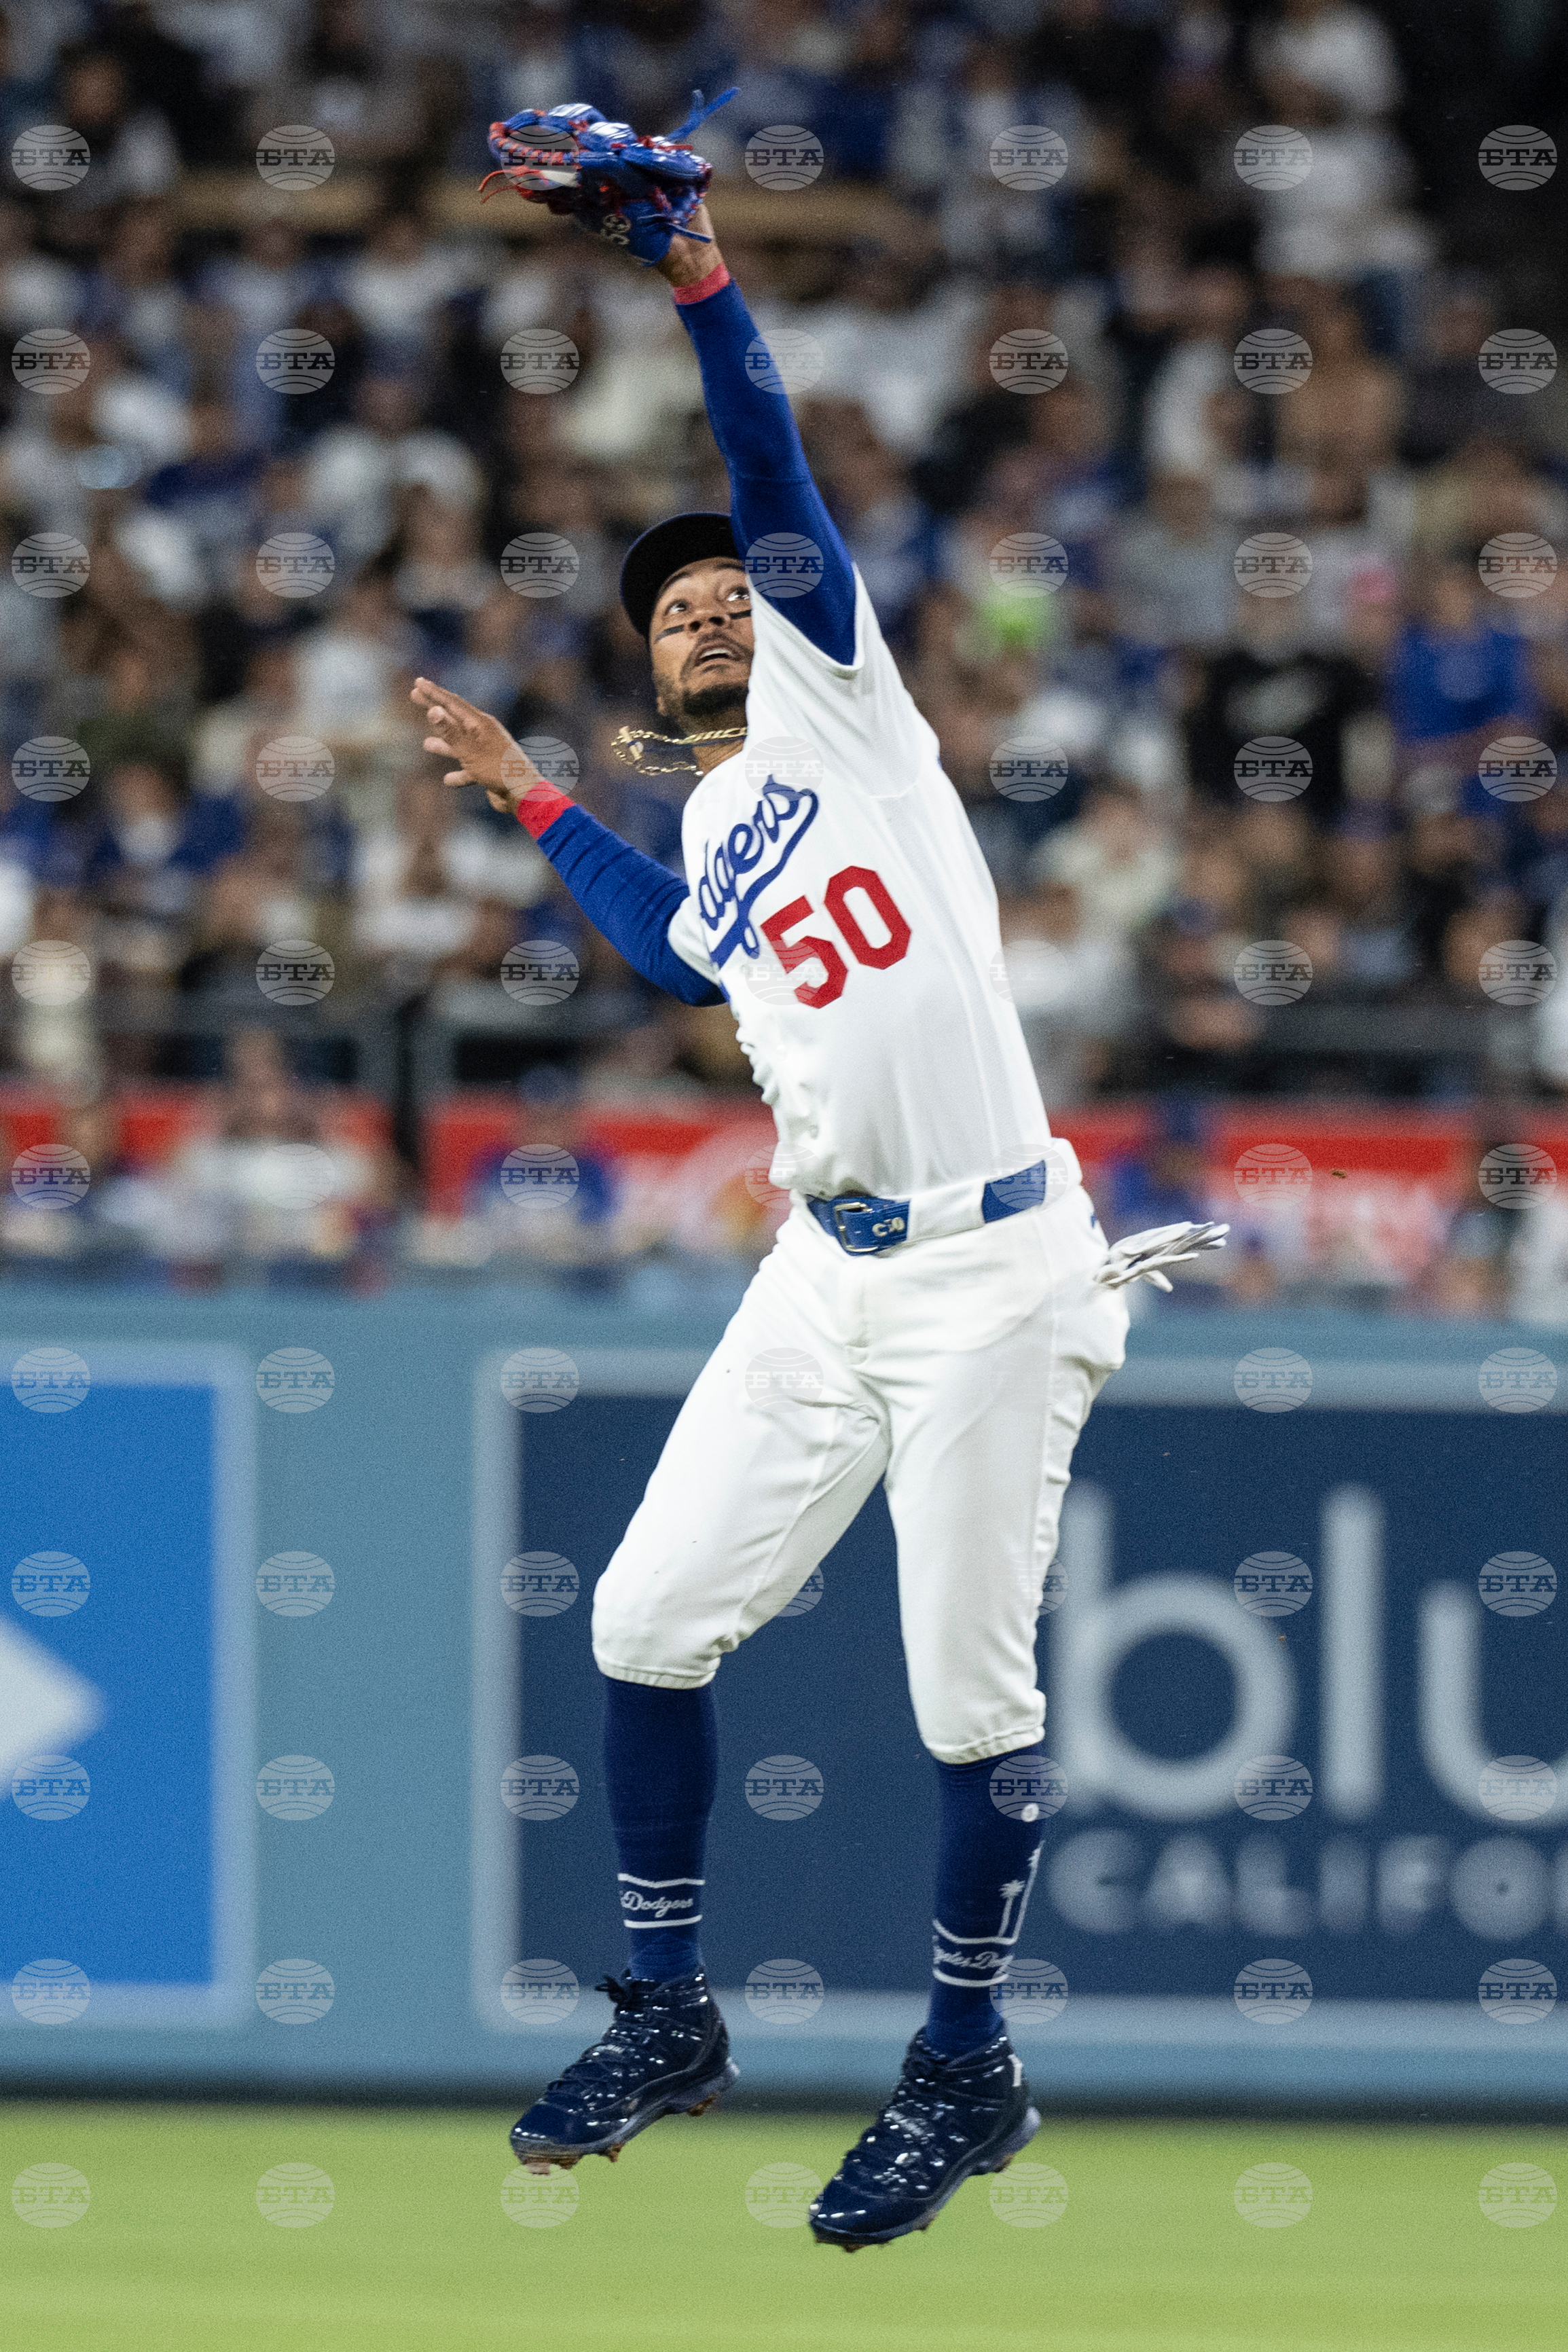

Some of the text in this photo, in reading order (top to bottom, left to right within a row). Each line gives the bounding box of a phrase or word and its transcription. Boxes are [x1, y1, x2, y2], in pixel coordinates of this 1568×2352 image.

[760, 865, 911, 1009] 50
[619, 1890, 694, 1919] Dodgers
[1049, 1830, 1568, 1939] CALIFO
